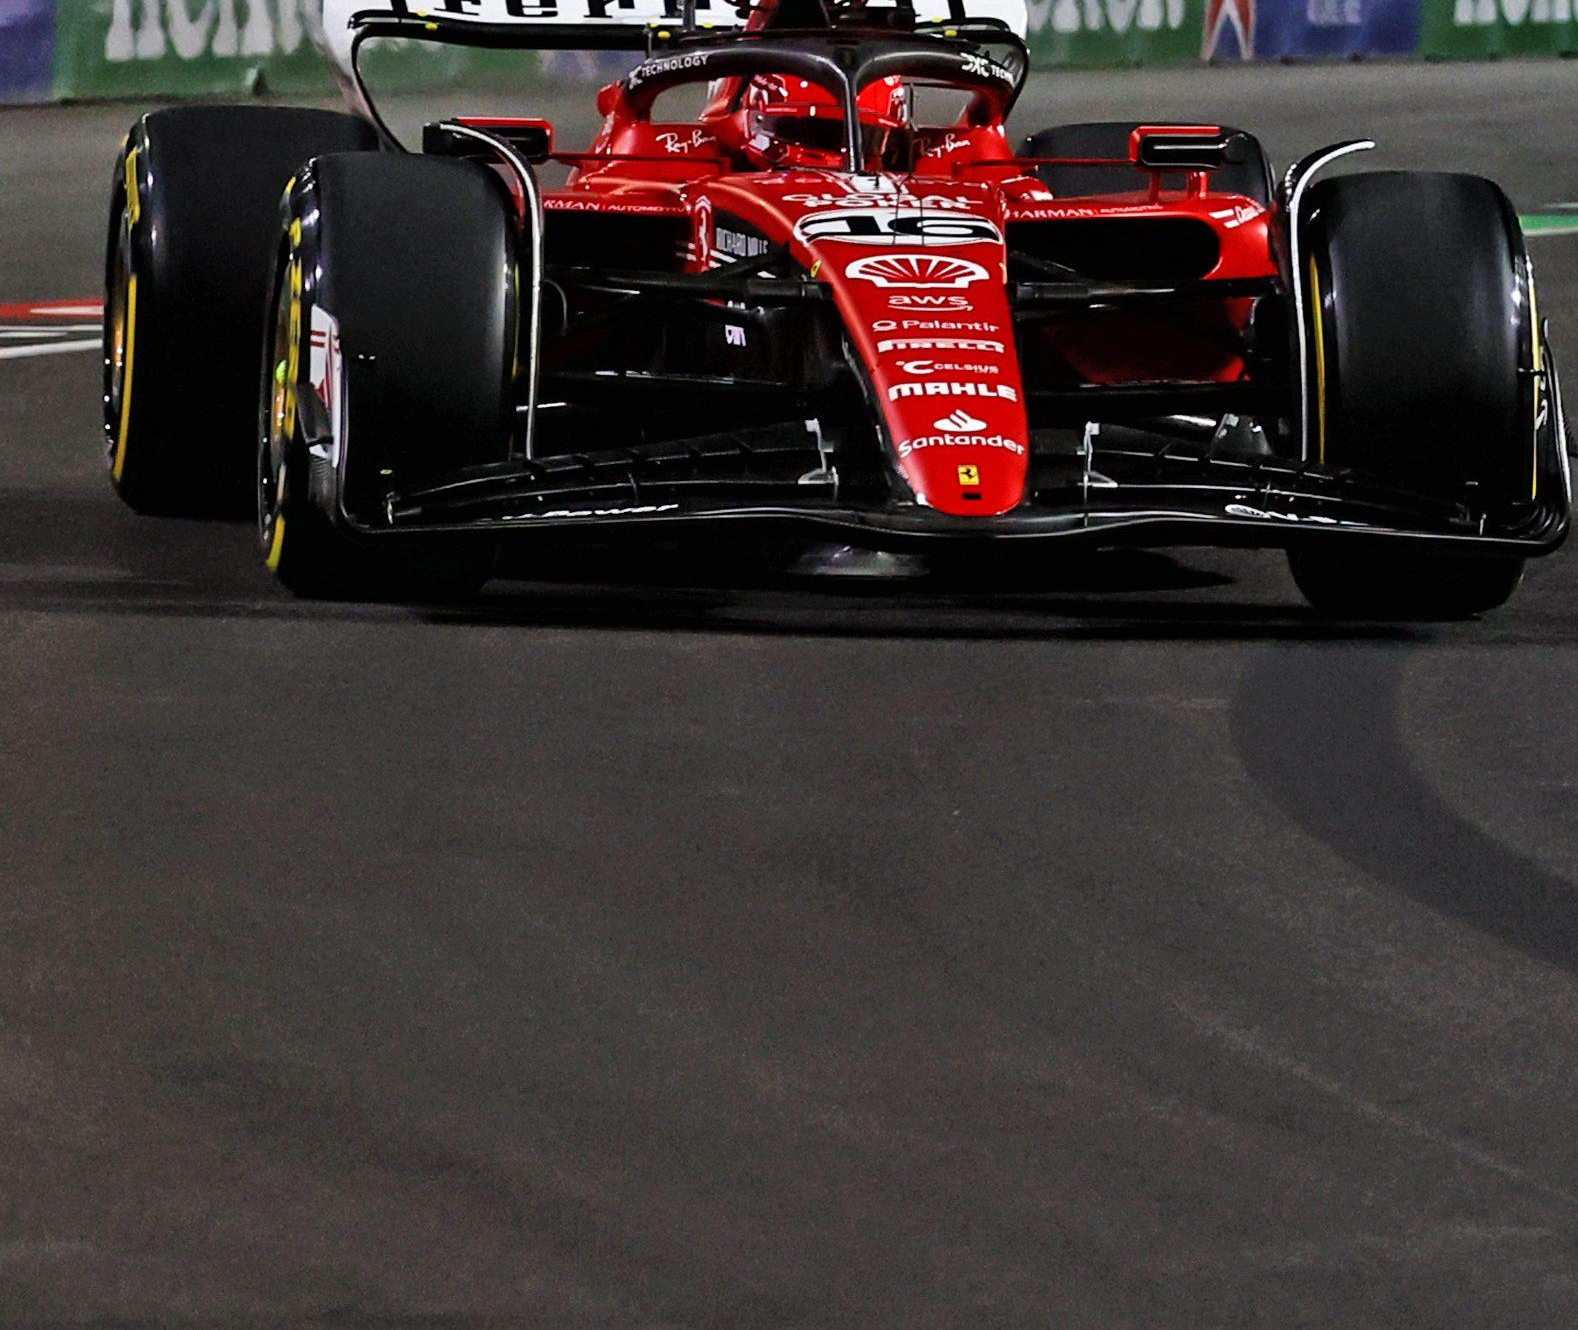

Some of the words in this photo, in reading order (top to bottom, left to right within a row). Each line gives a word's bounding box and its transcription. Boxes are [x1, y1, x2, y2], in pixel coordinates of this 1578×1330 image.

[642, 54, 709, 76] TECHNOLOGY
[656, 130, 717, 154] Ray-Ban
[799, 215, 1001, 244] 16
[888, 295, 970, 306] aws
[903, 320, 1000, 333] Palantir
[877, 338, 1004, 354] PIRELLI
[888, 382, 1017, 403] MAHLE
[898, 433, 1026, 458] Santander
